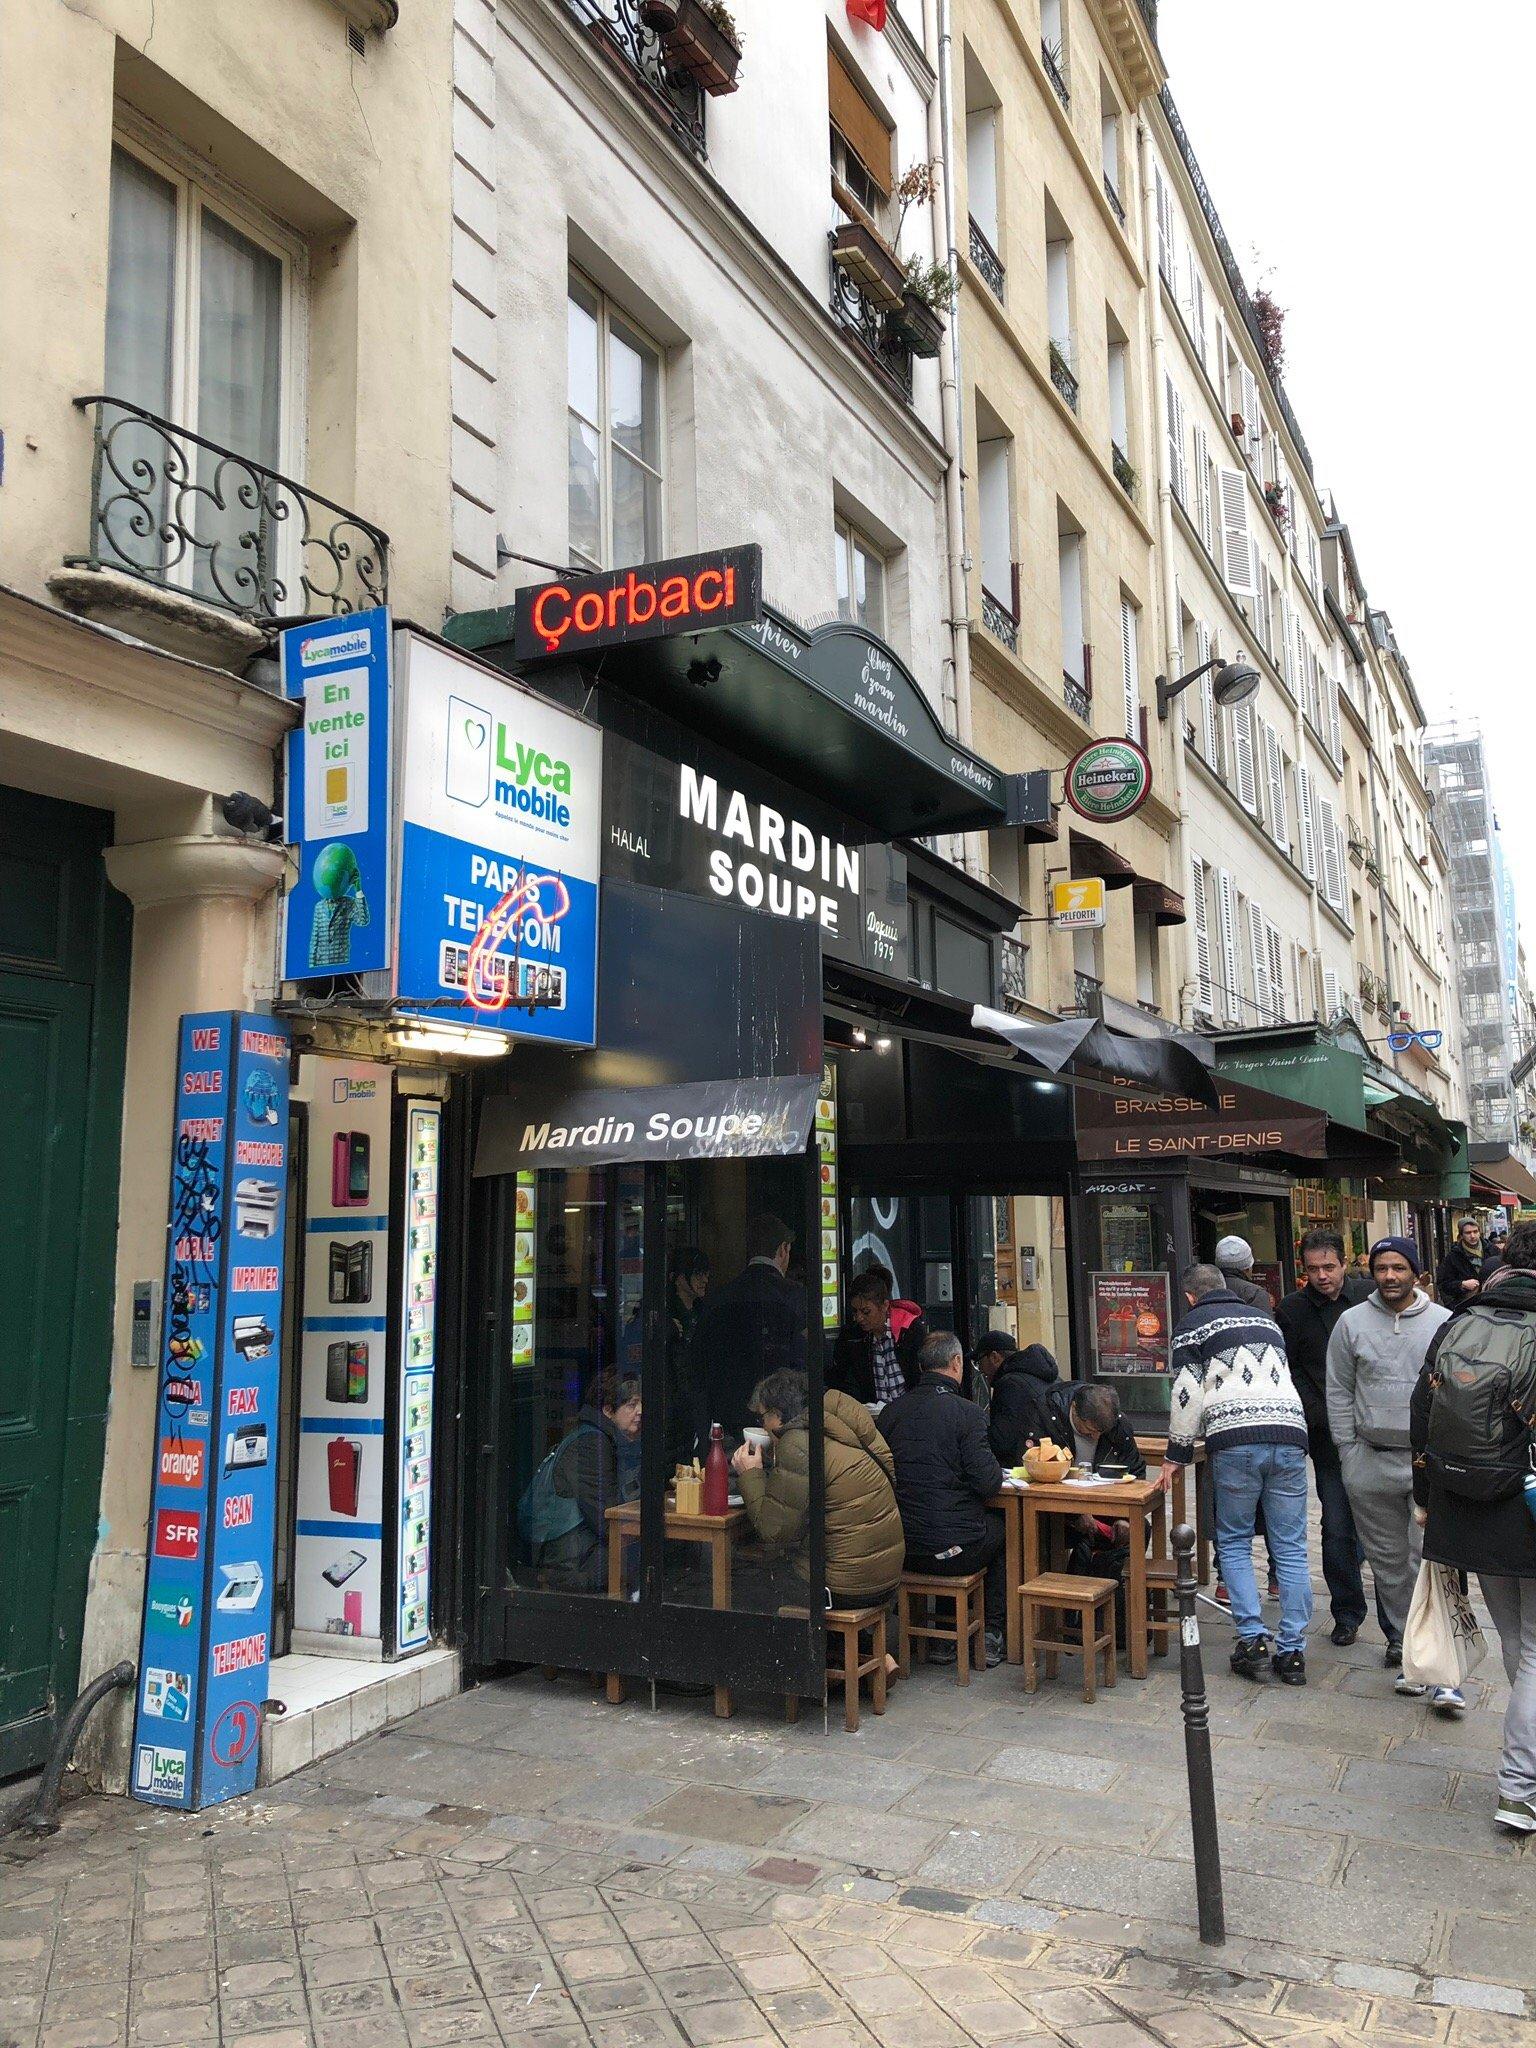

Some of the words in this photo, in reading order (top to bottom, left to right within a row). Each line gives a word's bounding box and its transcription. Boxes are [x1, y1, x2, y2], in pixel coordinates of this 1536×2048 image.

[304, 639, 367, 661] Lycamobile
[867, 646, 893, 682] Chez
[324, 684, 351, 704] En
[308, 711, 365, 735] vente
[853, 692, 909, 737] mardin
[325, 738, 349, 760] ici
[496, 722, 571, 796] Lyca
[1078, 770, 1136, 787] Heineken
[495, 778, 571, 828] mobile
[611, 825, 651, 858] HALAL
[679, 762, 860, 896] MARDIN
[471, 854, 541, 904] PARS
[709, 850, 839, 934] SOUPE
[867, 911, 899, 942] Depuis
[1060, 909, 1097, 922] PELFORTH
[873, 940, 895, 962] 1979
[192, 1027, 221, 1052] WE
[242, 1030, 288, 1057] INTERNET
[1267, 1056, 1297, 1067] Saint
[1299, 1054, 1330, 1064] Denis
[183, 1070, 223, 1095] SALE
[348, 1090, 376, 1099] mobile
[349, 1079, 377, 1092] Lyca
[1115, 1095, 1236, 1114] BRASSEIE
[180, 1117, 224, 1143] INTERNET
[519, 1116, 635, 1152] Mardin
[645, 1112, 763, 1143] Soupe
[1115, 1139, 1141, 1153] LE
[1148, 1131, 1283, 1152] SAINT-DENIS
[236, 1140, 284, 1167] PHOTOCOPIE
[174, 1236, 215, 1262] MOBILE
[232, 1266, 279, 1292] IMPRIMER
[228, 1387, 259, 1415] FAX
[161, 1453, 199, 1482] orange
[224, 1494, 253, 1528] SCAN
[166, 1524, 199, 1543] SFR
[213, 1633, 267, 1678] TELEPHONE
[154, 1752, 185, 1777] Lyca
[153, 1776, 184, 1791] mobile
